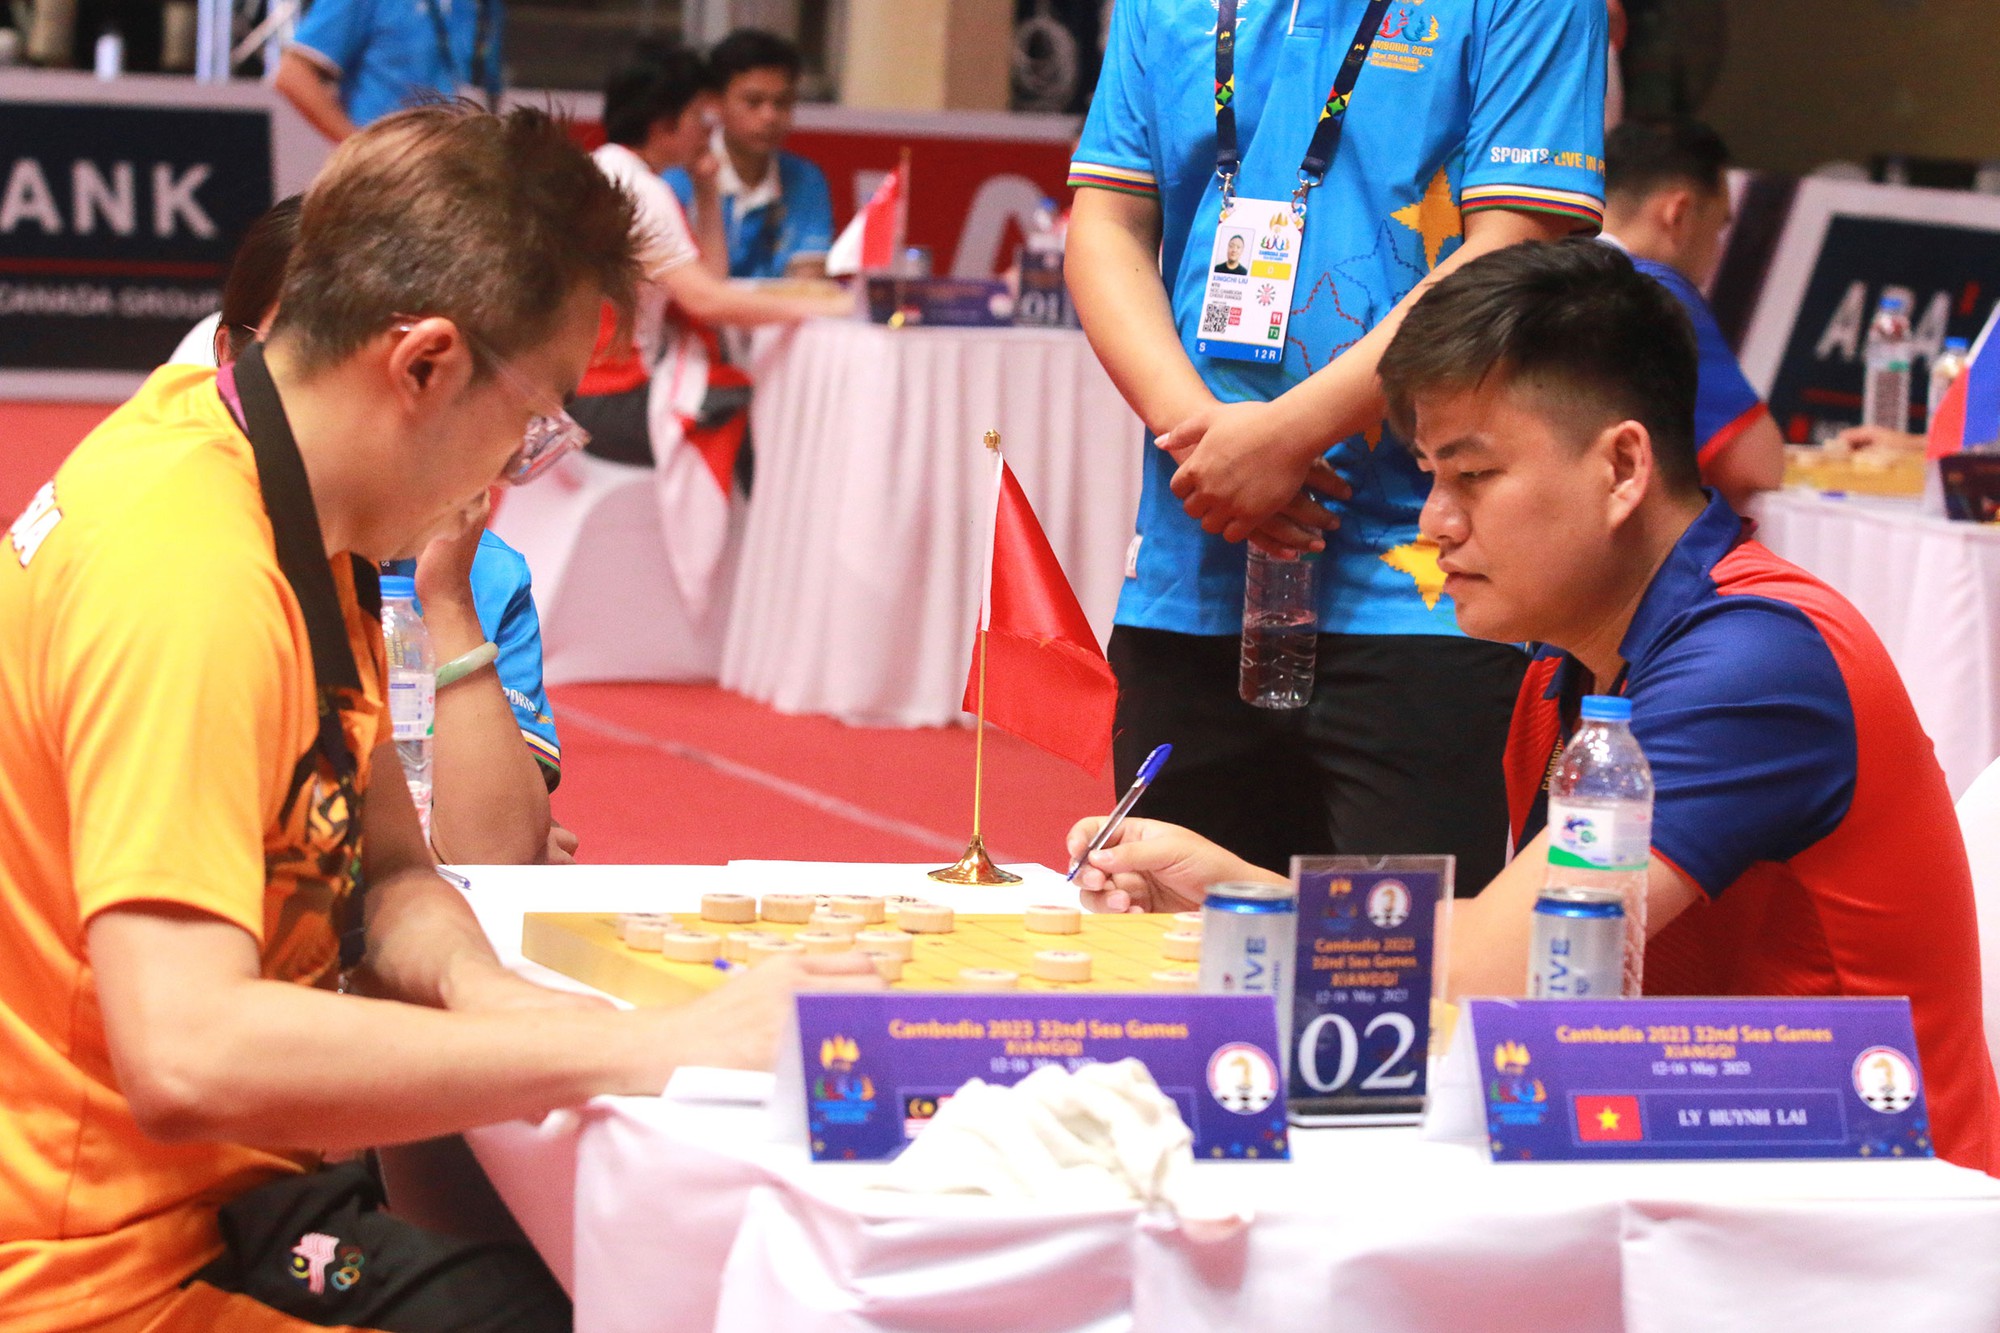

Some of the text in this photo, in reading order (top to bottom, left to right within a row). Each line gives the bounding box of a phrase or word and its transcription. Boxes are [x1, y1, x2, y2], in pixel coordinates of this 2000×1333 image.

[1411, 45, 1434, 57] 2023
[1490, 146, 1549, 164] SPORTS
[1554, 151, 1584, 168] LIVE
[1586, 154, 1597, 172] IN
[0, 157, 218, 239] ANK
[1314, 937, 1416, 953] Cambodia 2023
[1312, 954, 1418, 970] 32nd Sea Games
[1331, 972, 1399, 987] XIANGQI
[1352, 990, 1377, 1005] May
[888, 1019, 1189, 1039] Cambodia 2023 32nd Sea Games
[1555, 1024, 1833, 1043] Cambodia 2023 32nd Sea Games
[1005, 1039, 1083, 1056] XIANGQI
[1298, 1011, 1419, 1093] 02
[1664, 1043, 1737, 1059] XIANGQI
[1690, 1061, 1718, 1077] May
[1678, 1108, 1808, 1126] LY HUYNH LAI
